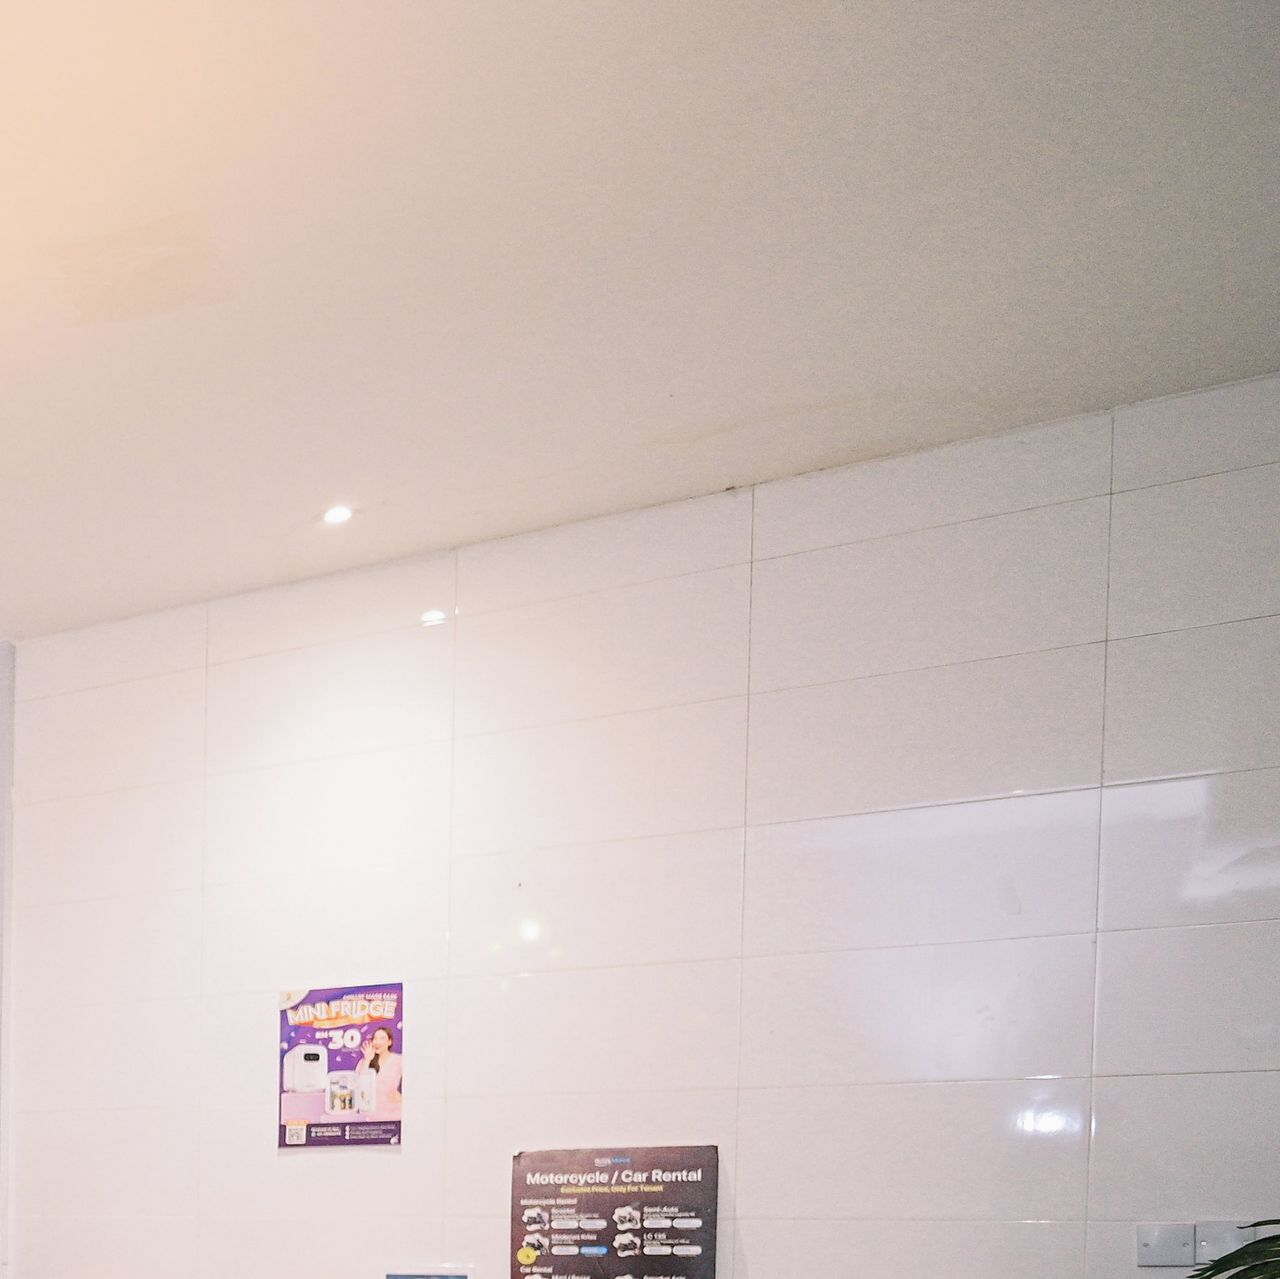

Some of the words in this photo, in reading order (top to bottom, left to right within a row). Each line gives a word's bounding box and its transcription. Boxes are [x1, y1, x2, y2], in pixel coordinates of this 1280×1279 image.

[286, 1001, 329, 1026] MINI
[329, 999, 397, 1020] FRIDGE
[328, 1028, 361, 1050] 30
[526, 1170, 609, 1187] Motorcycle
[611, 1170, 619, 1185] /
[621, 1168, 649, 1184] Car
[651, 1167, 702, 1182] Rental
